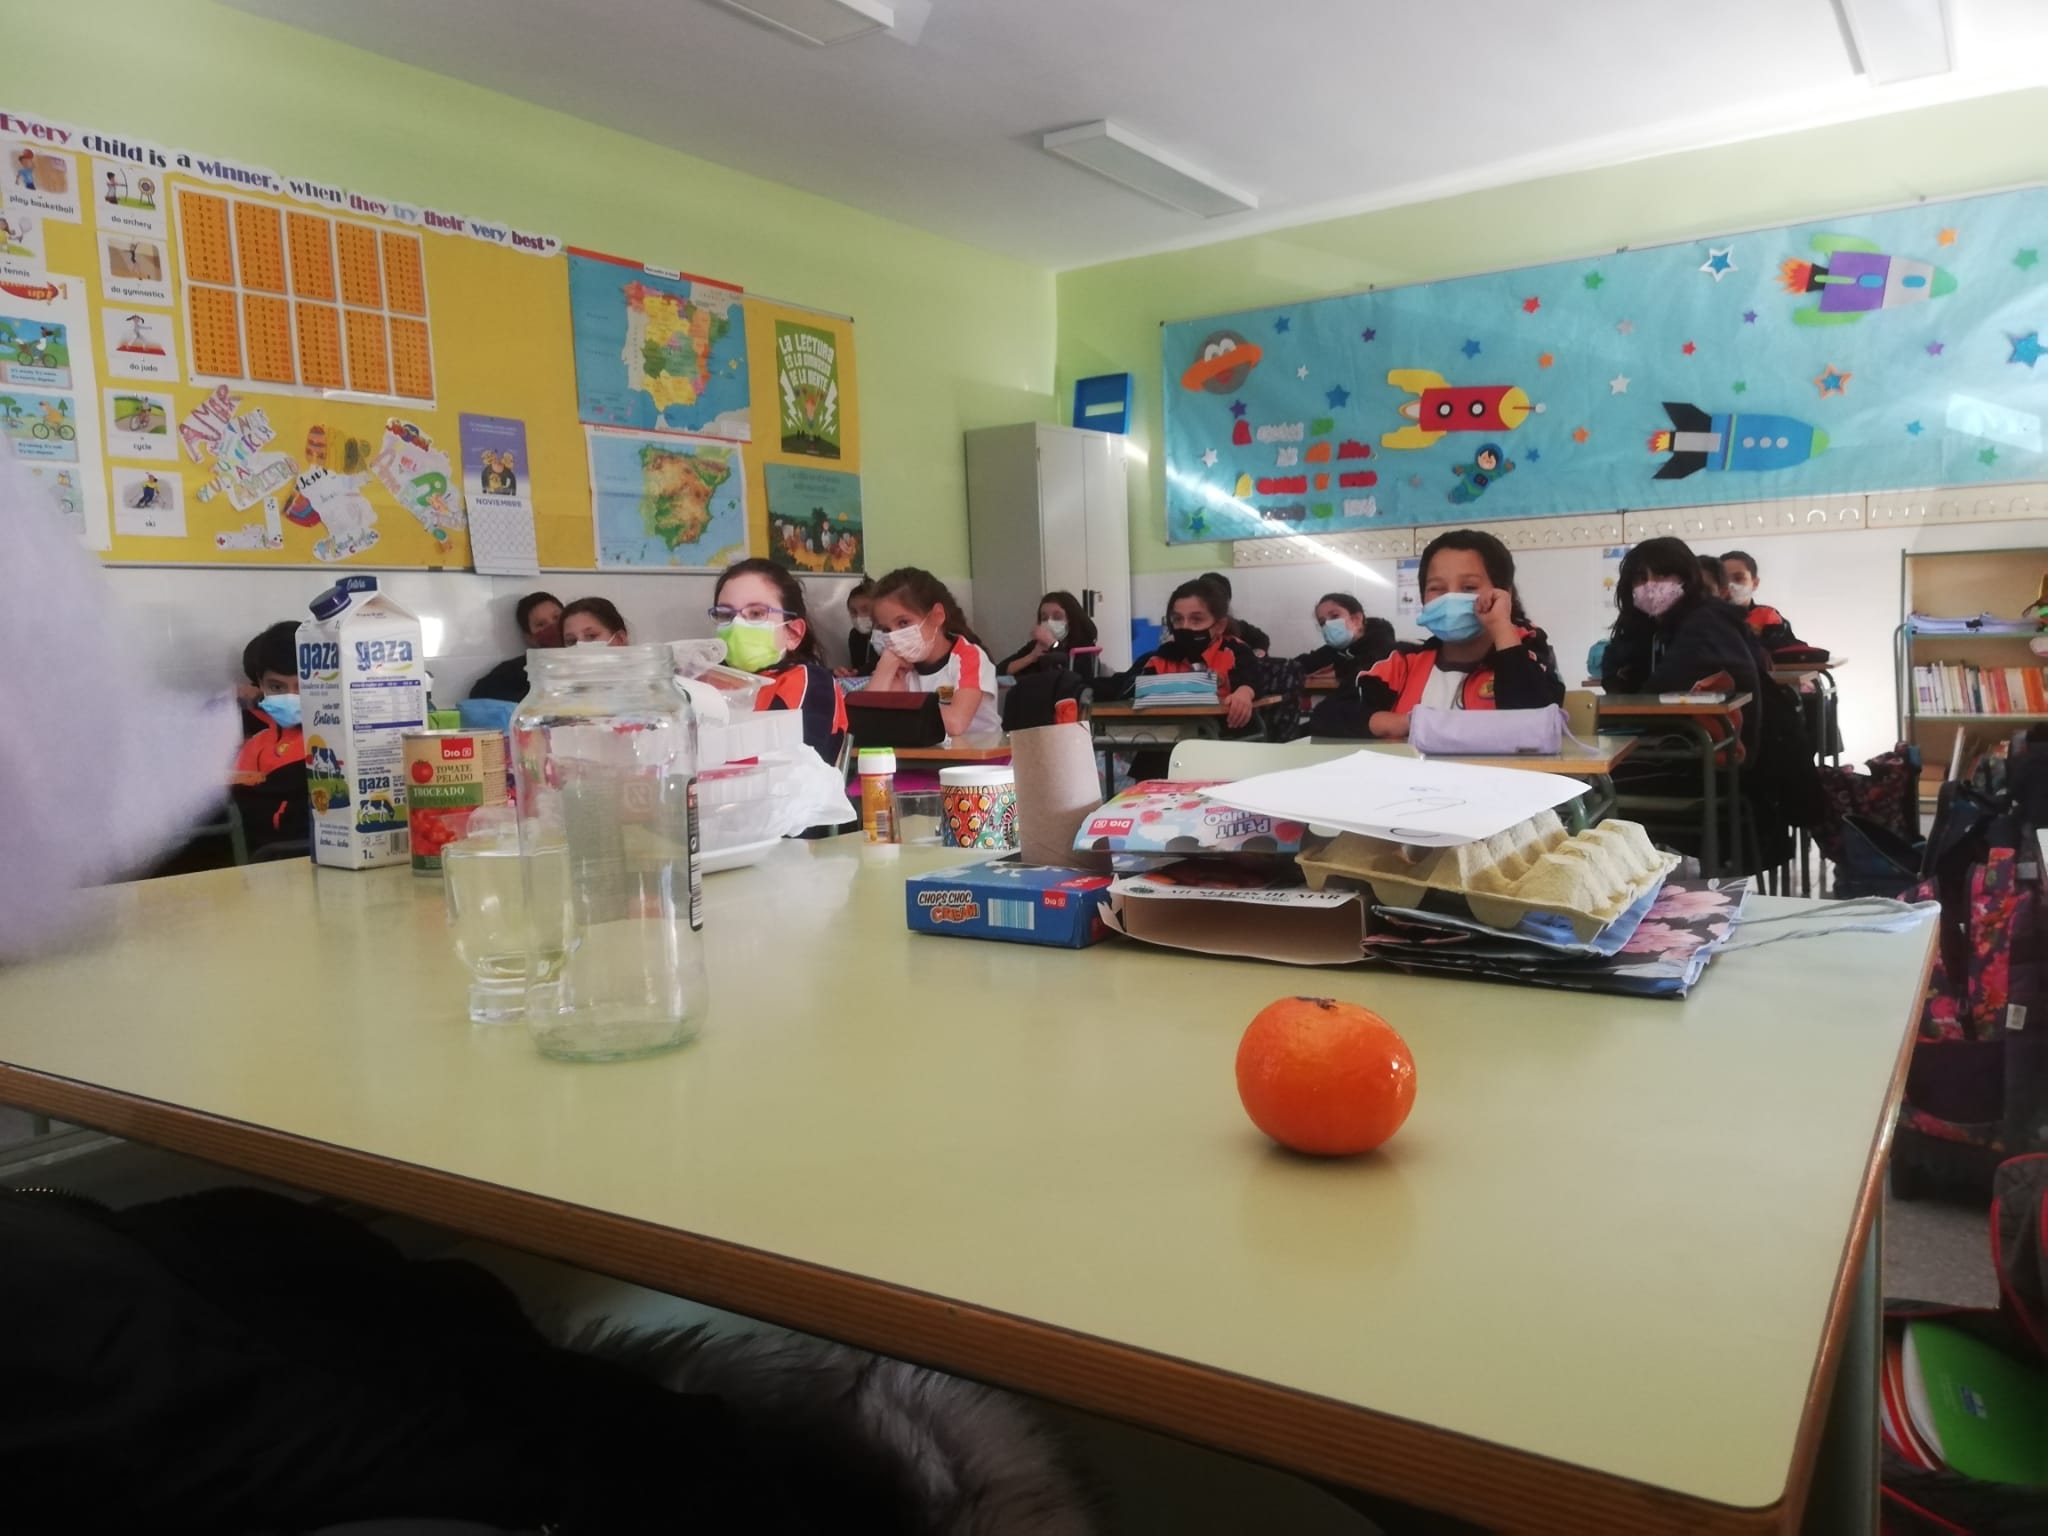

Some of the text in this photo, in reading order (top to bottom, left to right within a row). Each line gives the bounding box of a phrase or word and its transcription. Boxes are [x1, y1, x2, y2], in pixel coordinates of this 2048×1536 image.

[0, 113, 72, 145] Every
[82, 134, 143, 163] child
[150, 148, 167, 168] is
[176, 154, 191, 168] a
[197, 160, 280, 191] winner,
[289, 181, 342, 203] when
[350, 194, 389, 217] they
[392, 204, 418, 222] try
[424, 210, 465, 231] their
[471, 223, 507, 242] very
[10, 195, 74, 214] play basketball
[111, 215, 152, 230] do archery
[111, 286, 165, 299] do gymnastics
[129, 363, 158, 373] do judo
[133, 443, 152, 451] cycle
[476, 498, 522, 508] NOVIEMBRE
[300, 643, 339, 680] gaza
[355, 641, 413, 671] gaza
[436, 764, 472, 774] TOMATE
[358, 776, 390, 795] gaza
[436, 774, 473, 783] PELADO
[919, 890, 972, 905] CHOPS CHOC
